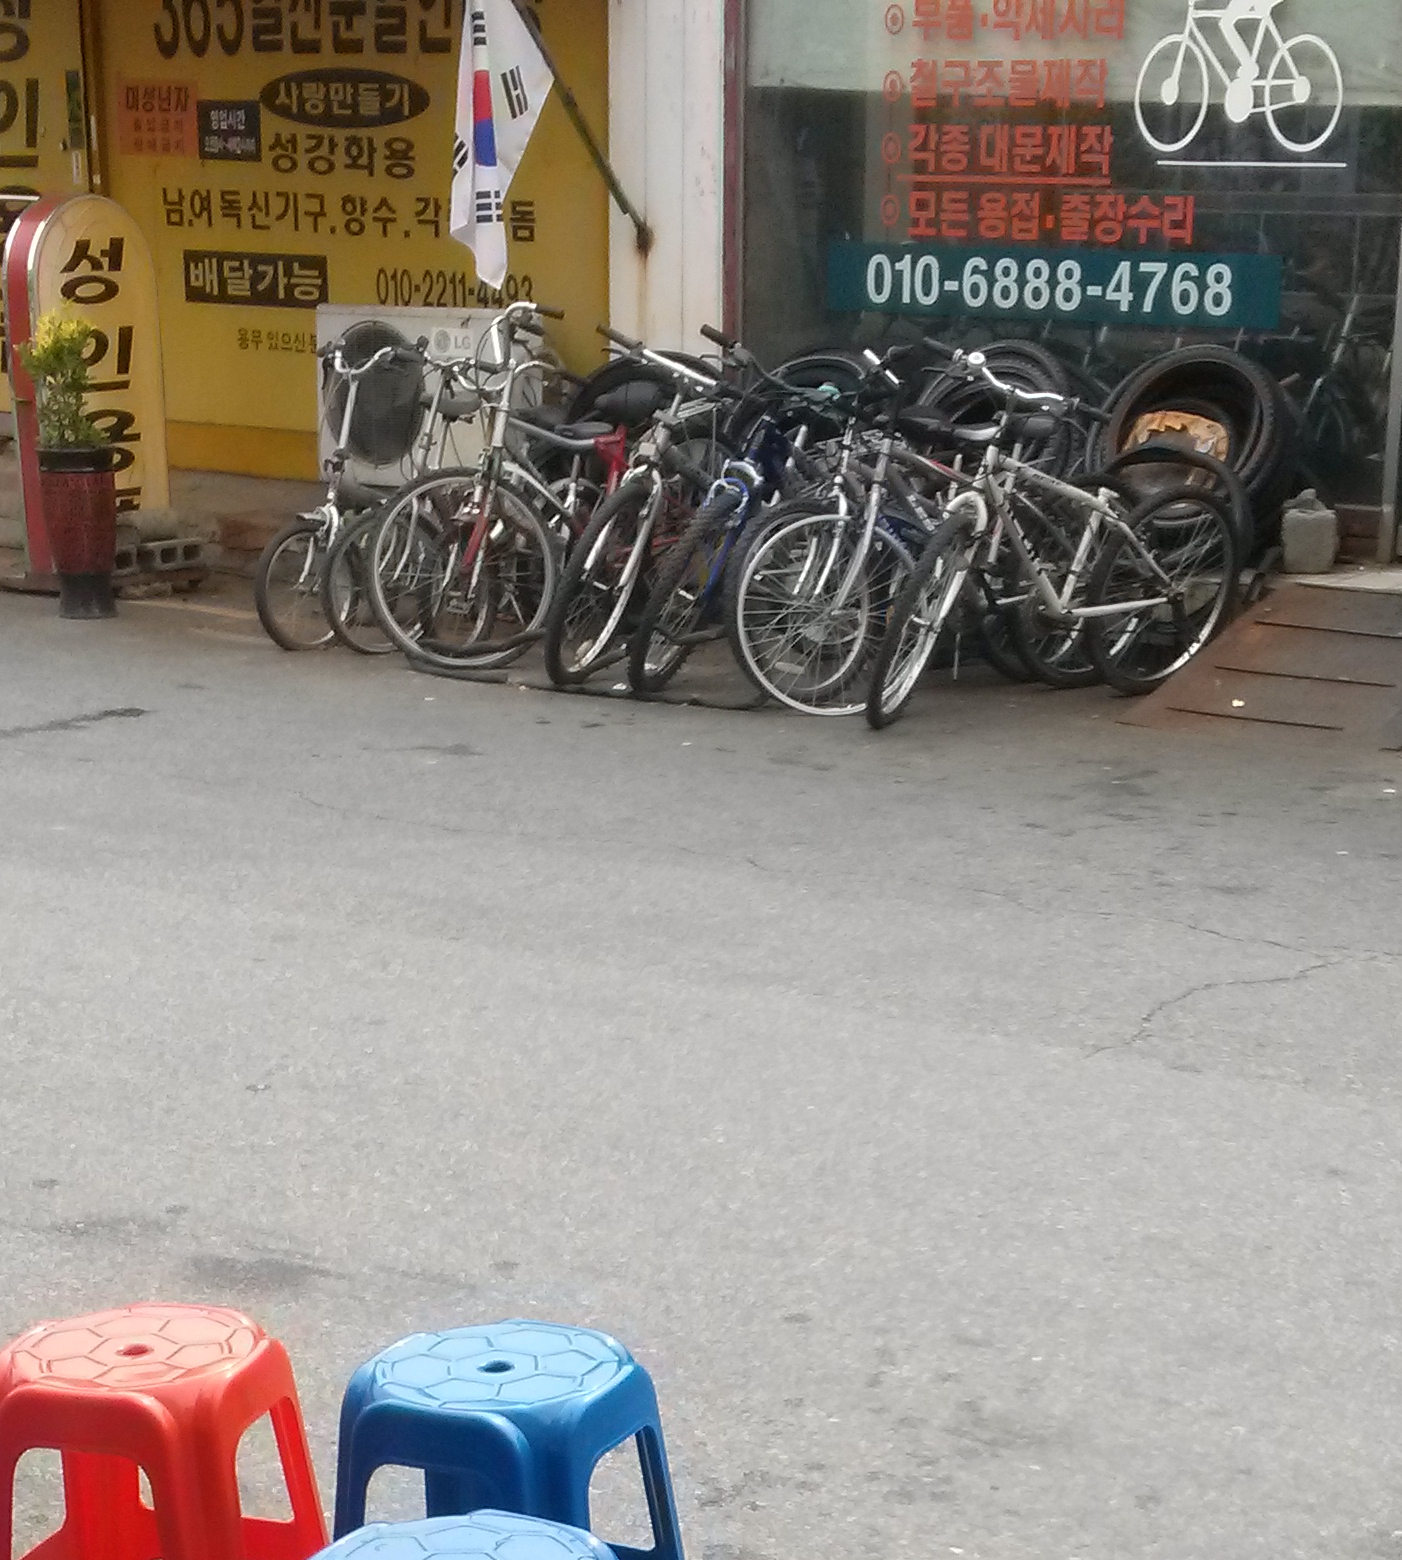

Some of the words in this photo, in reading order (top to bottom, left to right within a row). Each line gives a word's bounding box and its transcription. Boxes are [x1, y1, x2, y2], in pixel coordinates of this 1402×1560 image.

[126, 85, 189, 112] 미성년자
[210, 108, 246, 131] 영업시간
[277, 81, 410, 118] 사랑만들기
[268, 133, 417, 181] 성강화용
[908, 124, 970, 173] 각종
[979, 126, 1114, 176] 대문제작
[907, 190, 971, 239] 모든
[189, 256, 324, 301] 배달가능
[866, 254, 1232, 316] 010-6888-4768
[454, 338, 472, 350] LG
